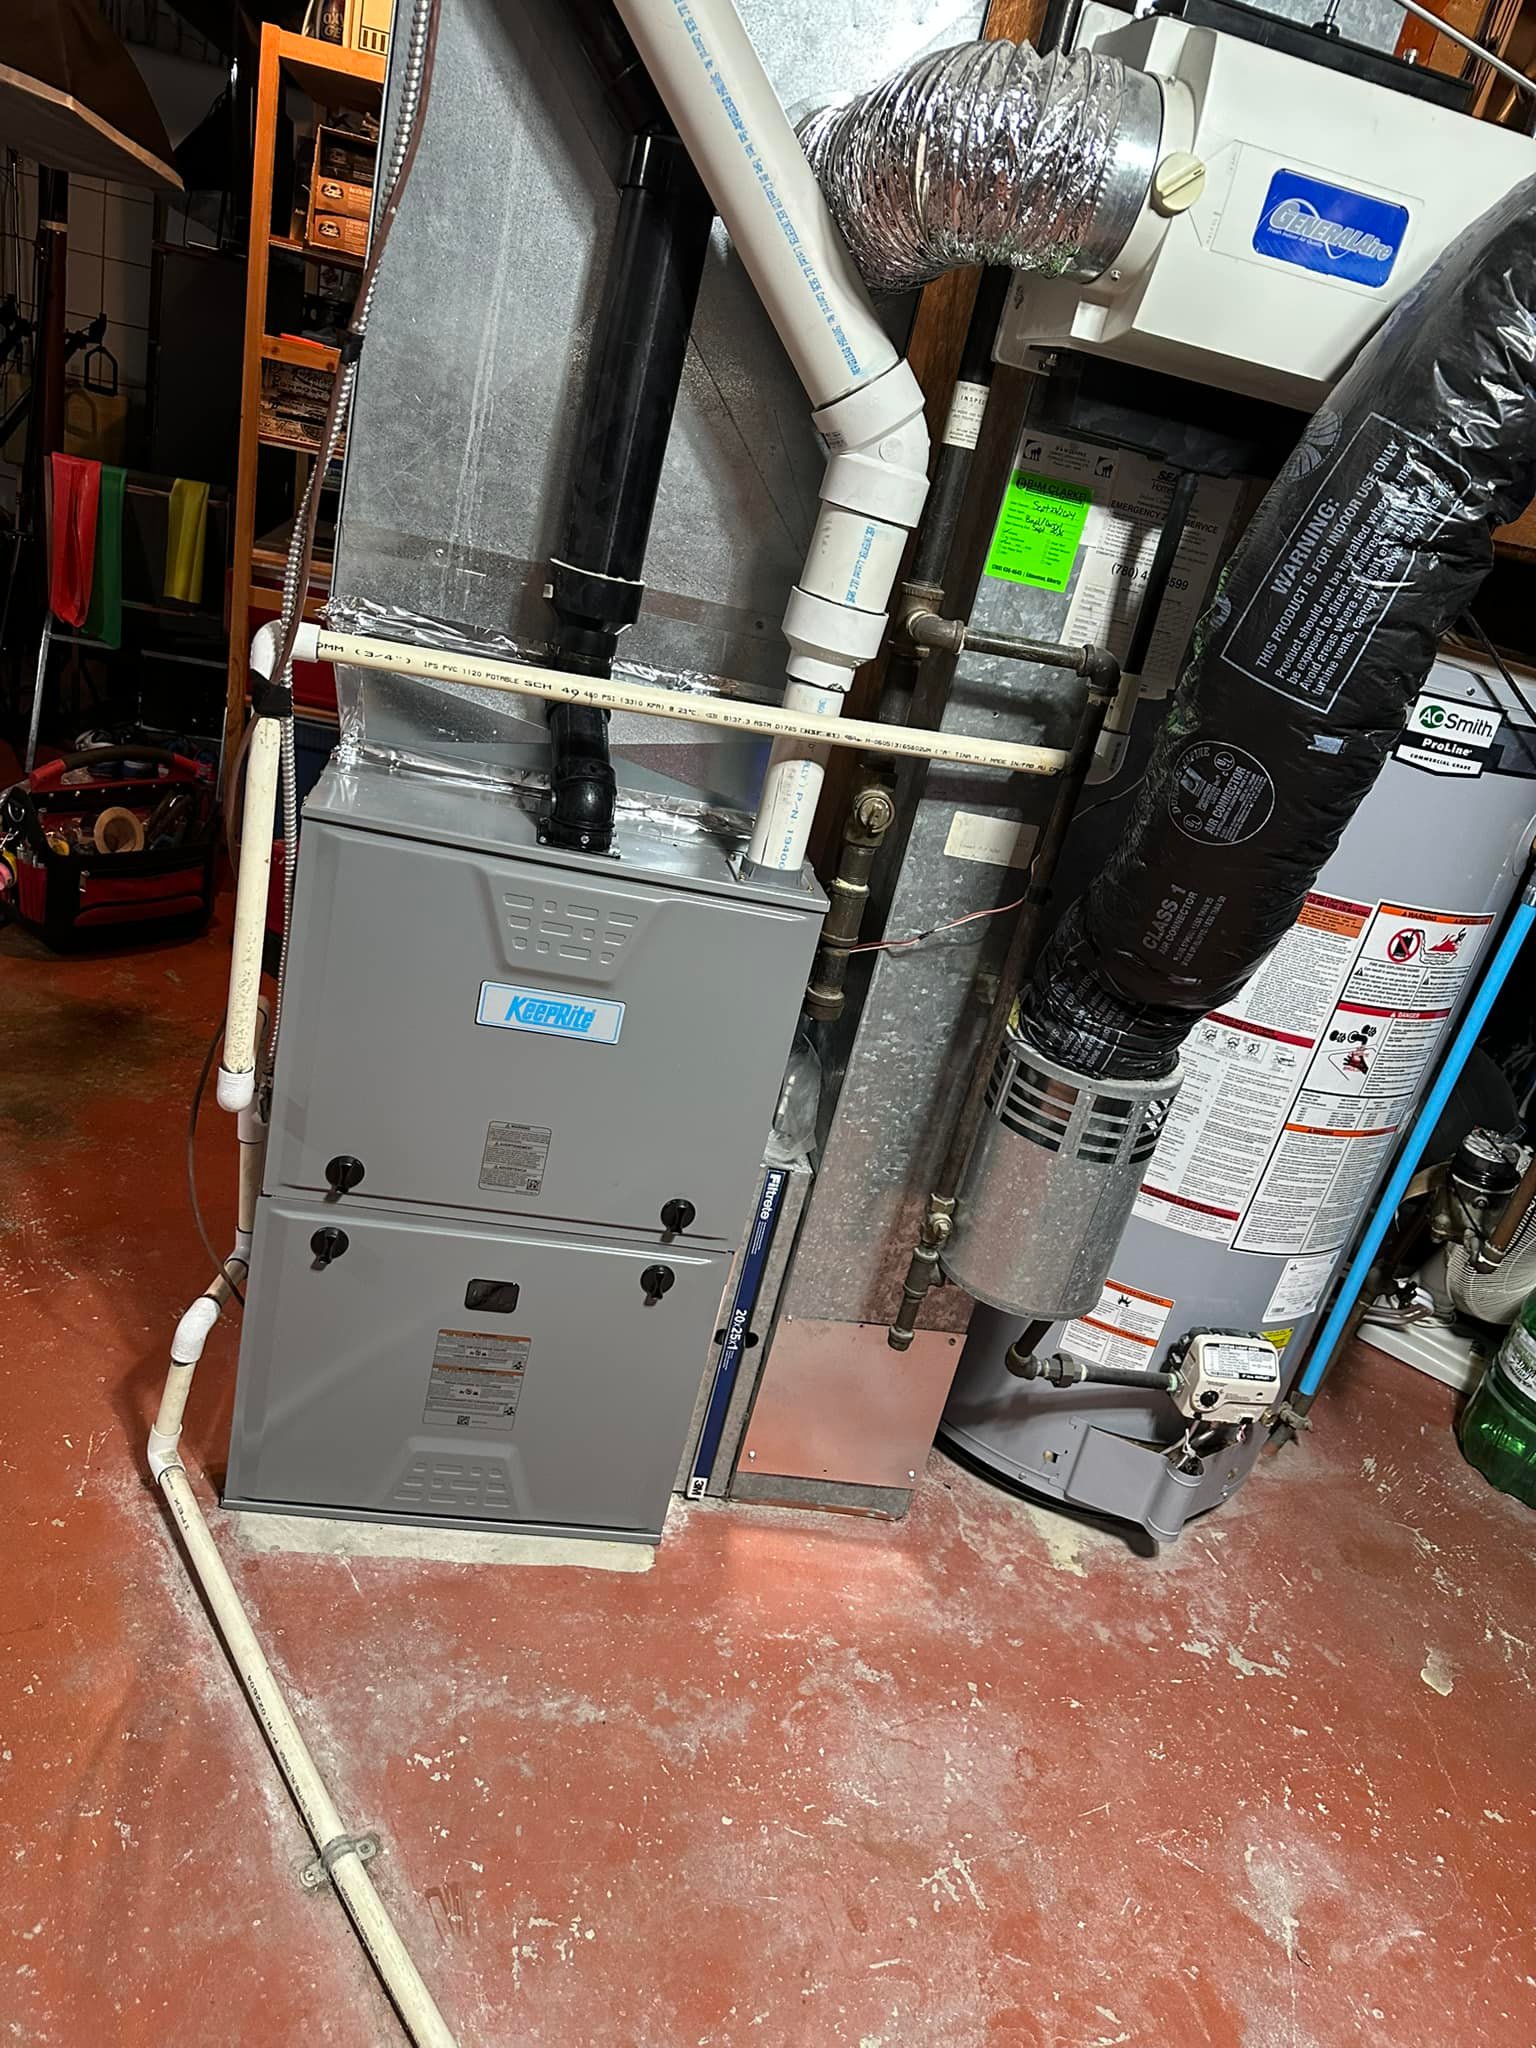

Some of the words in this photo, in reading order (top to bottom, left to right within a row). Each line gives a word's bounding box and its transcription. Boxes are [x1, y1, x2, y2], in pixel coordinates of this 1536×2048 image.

[692, 33, 710, 59] Control
[752, 158, 764, 175] Type
[793, 245, 809, 267] Listed
[815, 291, 833, 315] Control
[1373, 440, 1401, 474] ONLY
[1356, 471, 1379, 499] USE
[1110, 501, 1161, 520] EMERGENCY
[1185, 519, 1219, 535] SERVICE
[1328, 496, 1363, 549] INDOOR
[1366, 490, 1395, 526] where
[1270, 497, 1341, 596] WARNING:
[1311, 546, 1333, 576] FOR
[1339, 525, 1372, 575] installed
[1353, 528, 1385, 573] indirect
[852, 559, 865, 579] Listed
[1111, 562, 1139, 579] (780)
[1306, 572, 1319, 590] IS
[1329, 567, 1344, 587] be
[1348, 570, 1362, 587] or
[1321, 581, 1339, 607] not
[1328, 583, 1352, 620] direct
[1274, 587, 1310, 642] PRODUCT
[1299, 604, 1325, 645] should
[1320, 611, 1333, 630] to
[1255, 640, 1278, 670] THIS
[1275, 641, 1303, 680] Product
[1297, 625, 1326, 672] exposed
[1299, 658, 1323, 692] Avoid
[1318, 632, 1340, 661] areas
[1333, 599, 1359, 637] where
[1311, 658, 1339, 697] turbine
[1334, 630, 1360, 665] vents,
[1351, 591, 1382, 633] canopy
[1286, 667, 1302, 686] be
[442, 663, 459, 673] PVC
[463, 666, 482, 678] 1120
[485, 671, 520, 685] POTABLE
[524, 679, 552, 691] SCH
[561, 686, 580, 697] 40
[602, 693, 616, 703] PSI
[620, 695, 644, 707] (3310
[753, 719, 773, 730] ASTM
[1410, 752, 1450, 767] COMMERCIAL
[1421, 738, 1473, 757] ProLine
[1204, 817, 1220, 834] AIR
[1212, 765, 1248, 818] CONNECTOR
[1142, 898, 1180, 950] CLASS
[1170, 883, 1187, 895] 1
[1165, 891, 1199, 942] CONNECTOR
[1406, 911, 1438, 922] WARNING
[505, 994, 596, 1032] KeepRite
[759, 1173, 782, 1220] Filtrete
[726, 1308, 748, 1350] 20x25x1
[691, 1479, 705, 1496] 3M
[174, 1497, 191, 1531] IPEX
